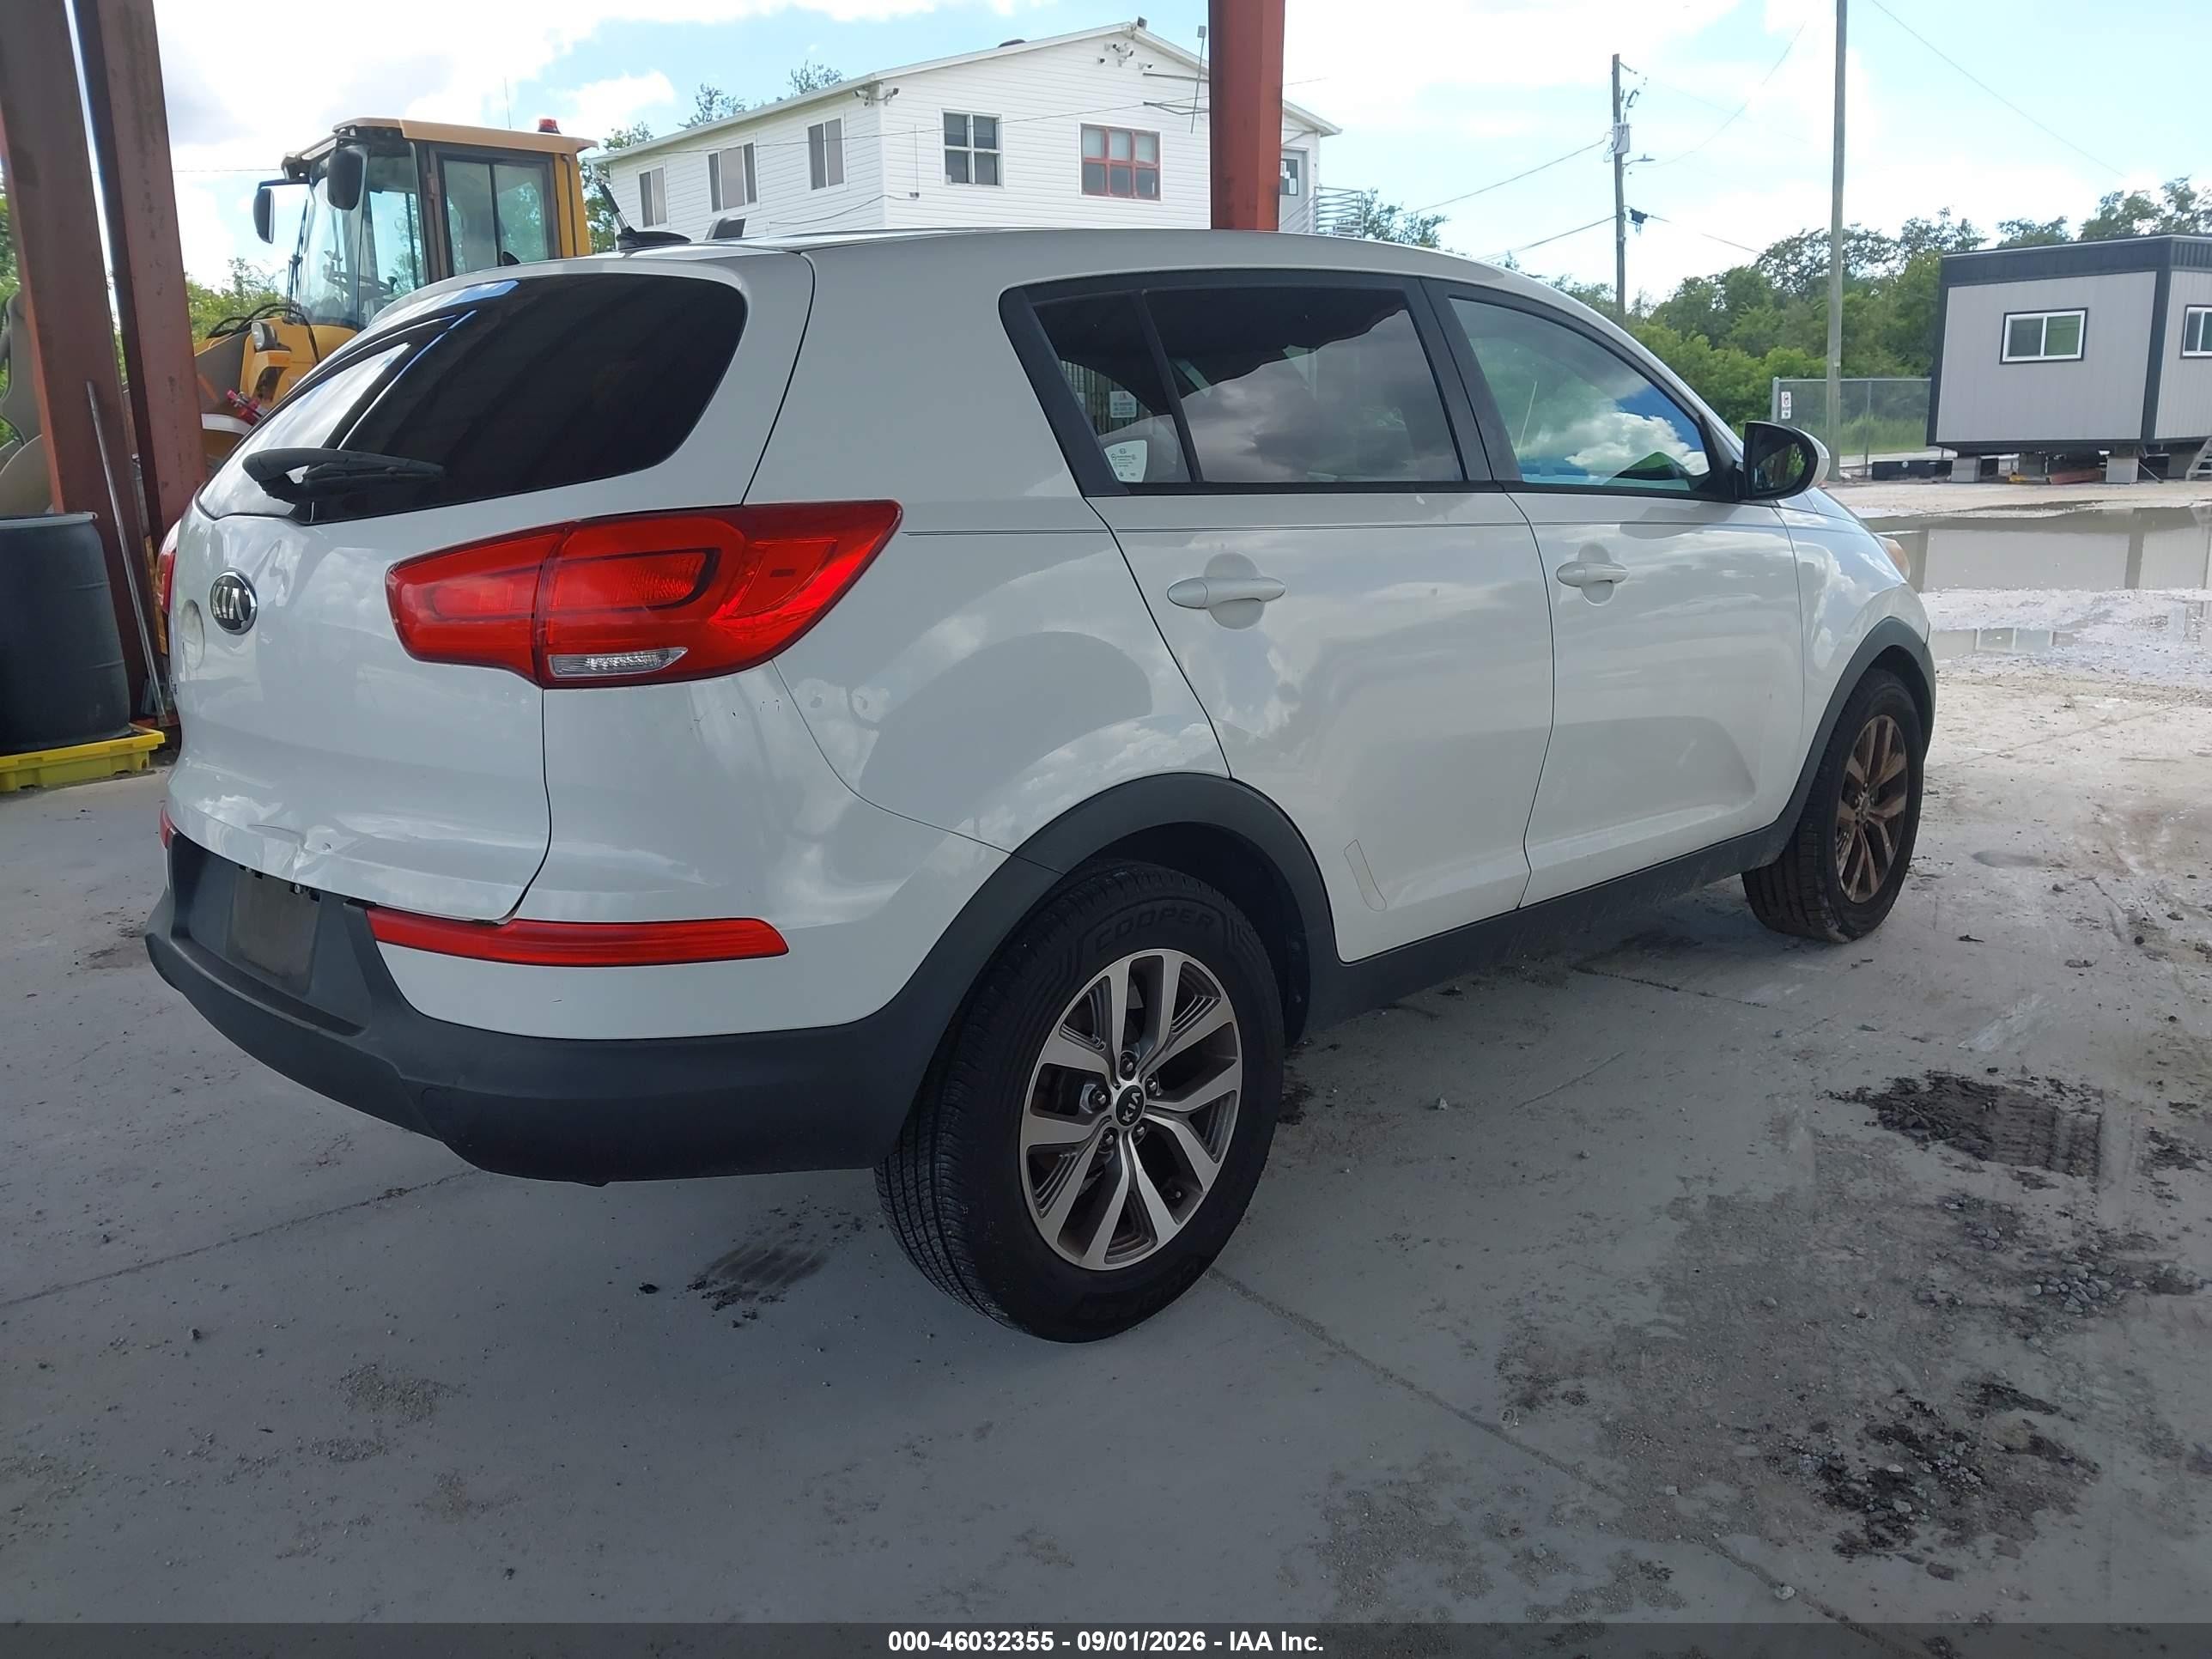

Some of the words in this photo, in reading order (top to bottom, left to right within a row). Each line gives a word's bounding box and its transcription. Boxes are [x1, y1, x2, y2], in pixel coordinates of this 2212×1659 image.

[213, 586, 244, 621] KIA
[1097, 906, 1215, 951] COOPER
[1122, 1092, 1141, 1122] KIA
